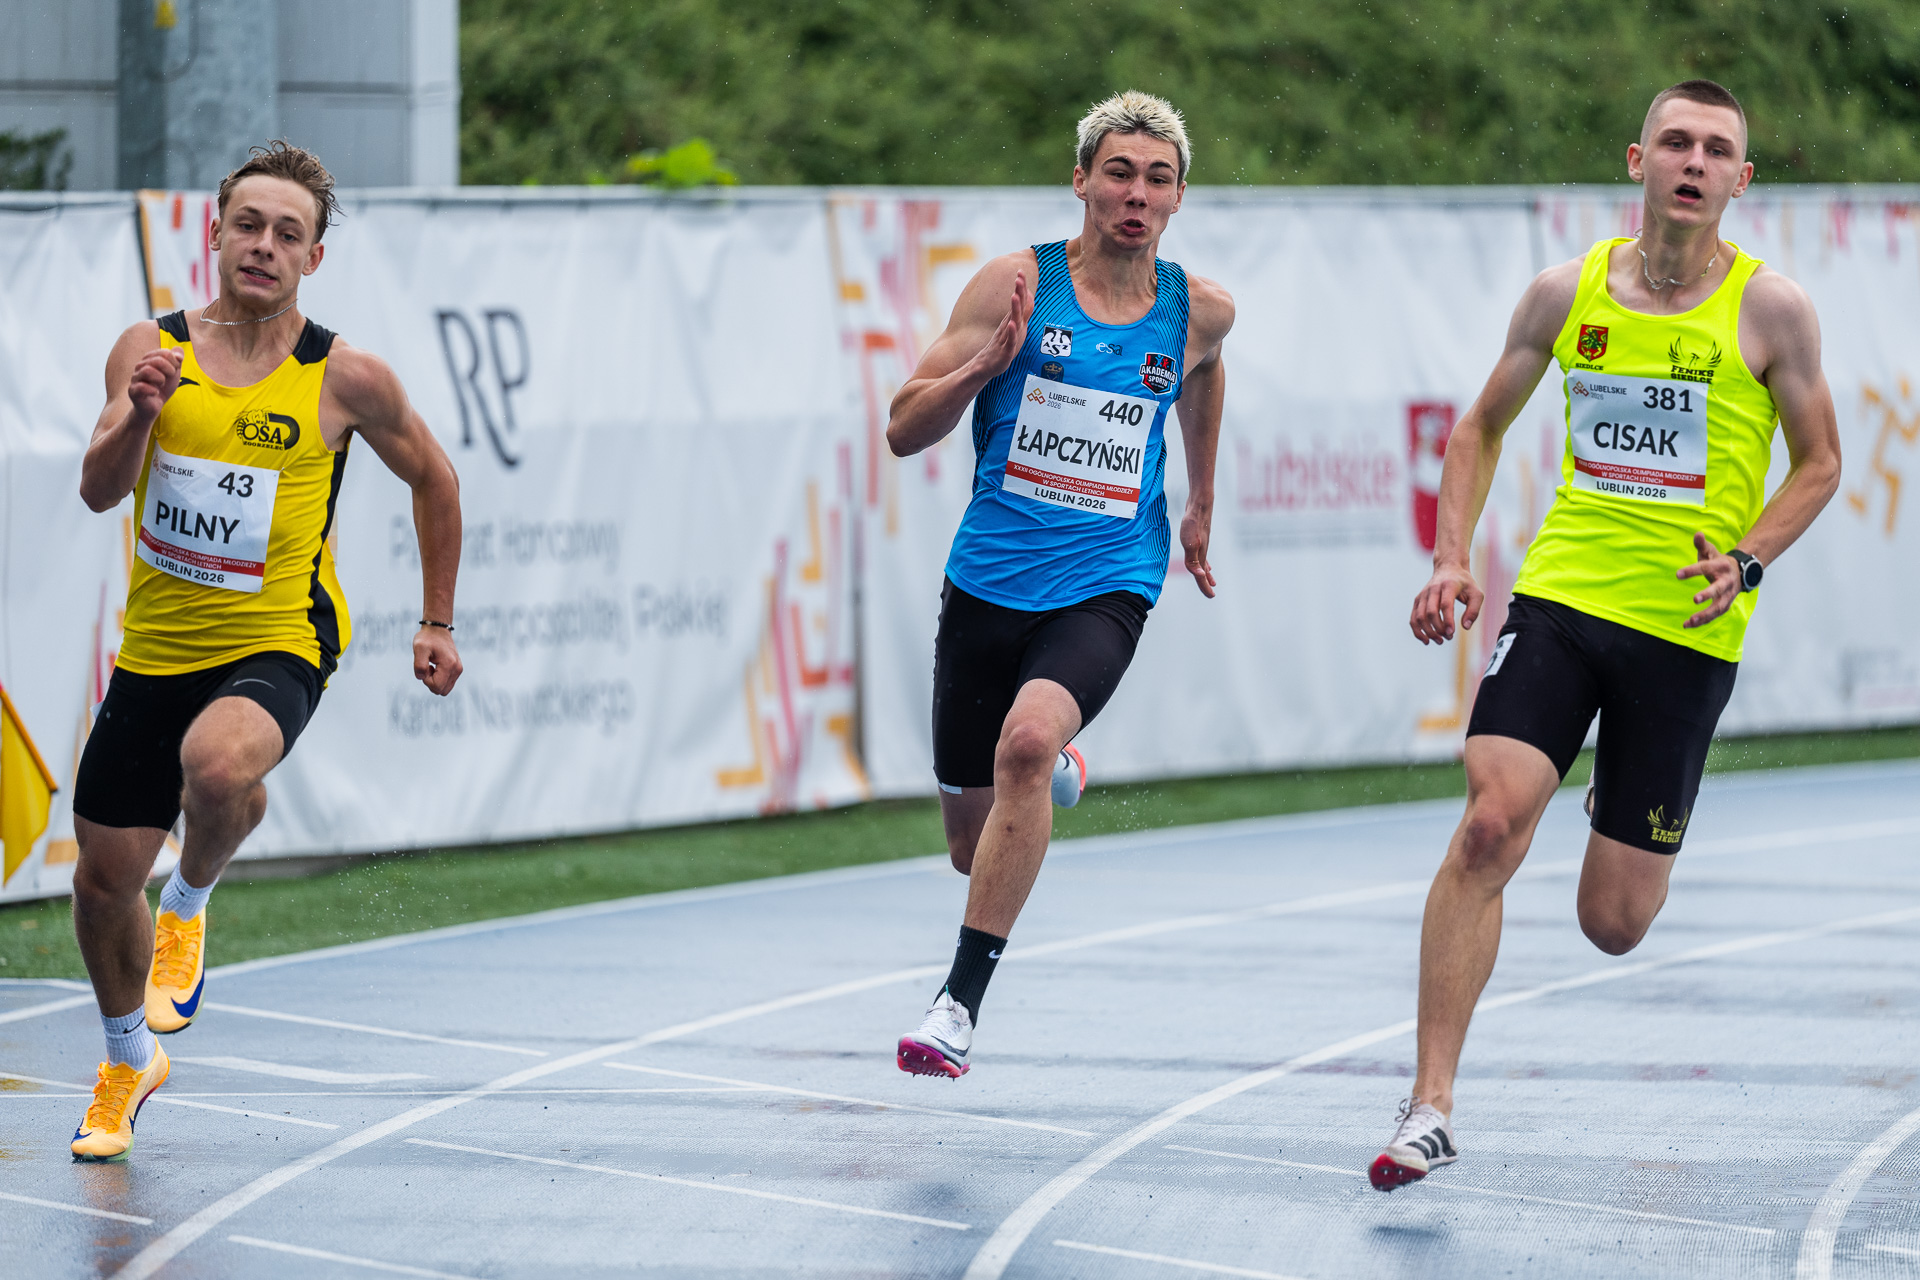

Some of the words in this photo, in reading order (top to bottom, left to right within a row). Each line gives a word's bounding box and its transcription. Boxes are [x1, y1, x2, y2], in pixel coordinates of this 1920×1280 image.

[1096, 342, 1123, 356] esa
[1141, 365, 1175, 383] AKADEMIA
[1575, 362, 1604, 371] SIEDLCE
[1671, 365, 1714, 378] FENIKS
[436, 309, 530, 467] RP
[1148, 375, 1169, 387] SPORTU
[1589, 384, 1628, 395] LUBELSKIE
[1046, 400, 1062, 410] 2026
[1048, 391, 1087, 407] LUBELSKIE
[1643, 385, 1693, 413] 381
[1099, 399, 1144, 427] 440
[243, 423, 283, 445] OSA
[1593, 421, 1679, 458] CISAK
[243, 440, 284, 451] ZGORZELEC
[1017, 424, 1141, 475] ŁAPCZYŃSKI
[158, 460, 195, 478] LUBELSKIE
[1587, 462, 1631, 474] OGÓLNOPOLSKA
[1632, 468, 1664, 478] OLIMPIADA
[1664, 472, 1698, 482] MŁODZIEŻY
[1608, 472, 1639, 482] SPORTACH
[1639, 476, 1664, 484] LETNICH
[217, 471, 254, 498] 43
[1013, 464, 1028, 473] XXXII
[1029, 467, 1075, 485] OGÓLNOPOLSKA
[1075, 479, 1106, 491] OLIMPIADA
[1106, 485, 1134, 496] MŁODZIEŻY
[1042, 478, 1049, 486] W
[1049, 480, 1081, 493] SPORTACH
[1081, 487, 1105, 497] LETNICH
[1596, 480, 1635, 495] LUBLIN
[1637, 486, 1667, 499] 2026
[1034, 487, 1076, 505] LUBLIN
[1077, 496, 1107, 510] 2026
[155, 499, 241, 545] PILNY
[167, 550, 197, 565] SPORTACH
[197, 558, 222, 570] LETNICH
[190, 551, 222, 564] OLIMPIADA
[223, 558, 257, 569] MŁODZIEŻY
[155, 556, 192, 577] LUBLIN
[194, 569, 225, 584] 2026
